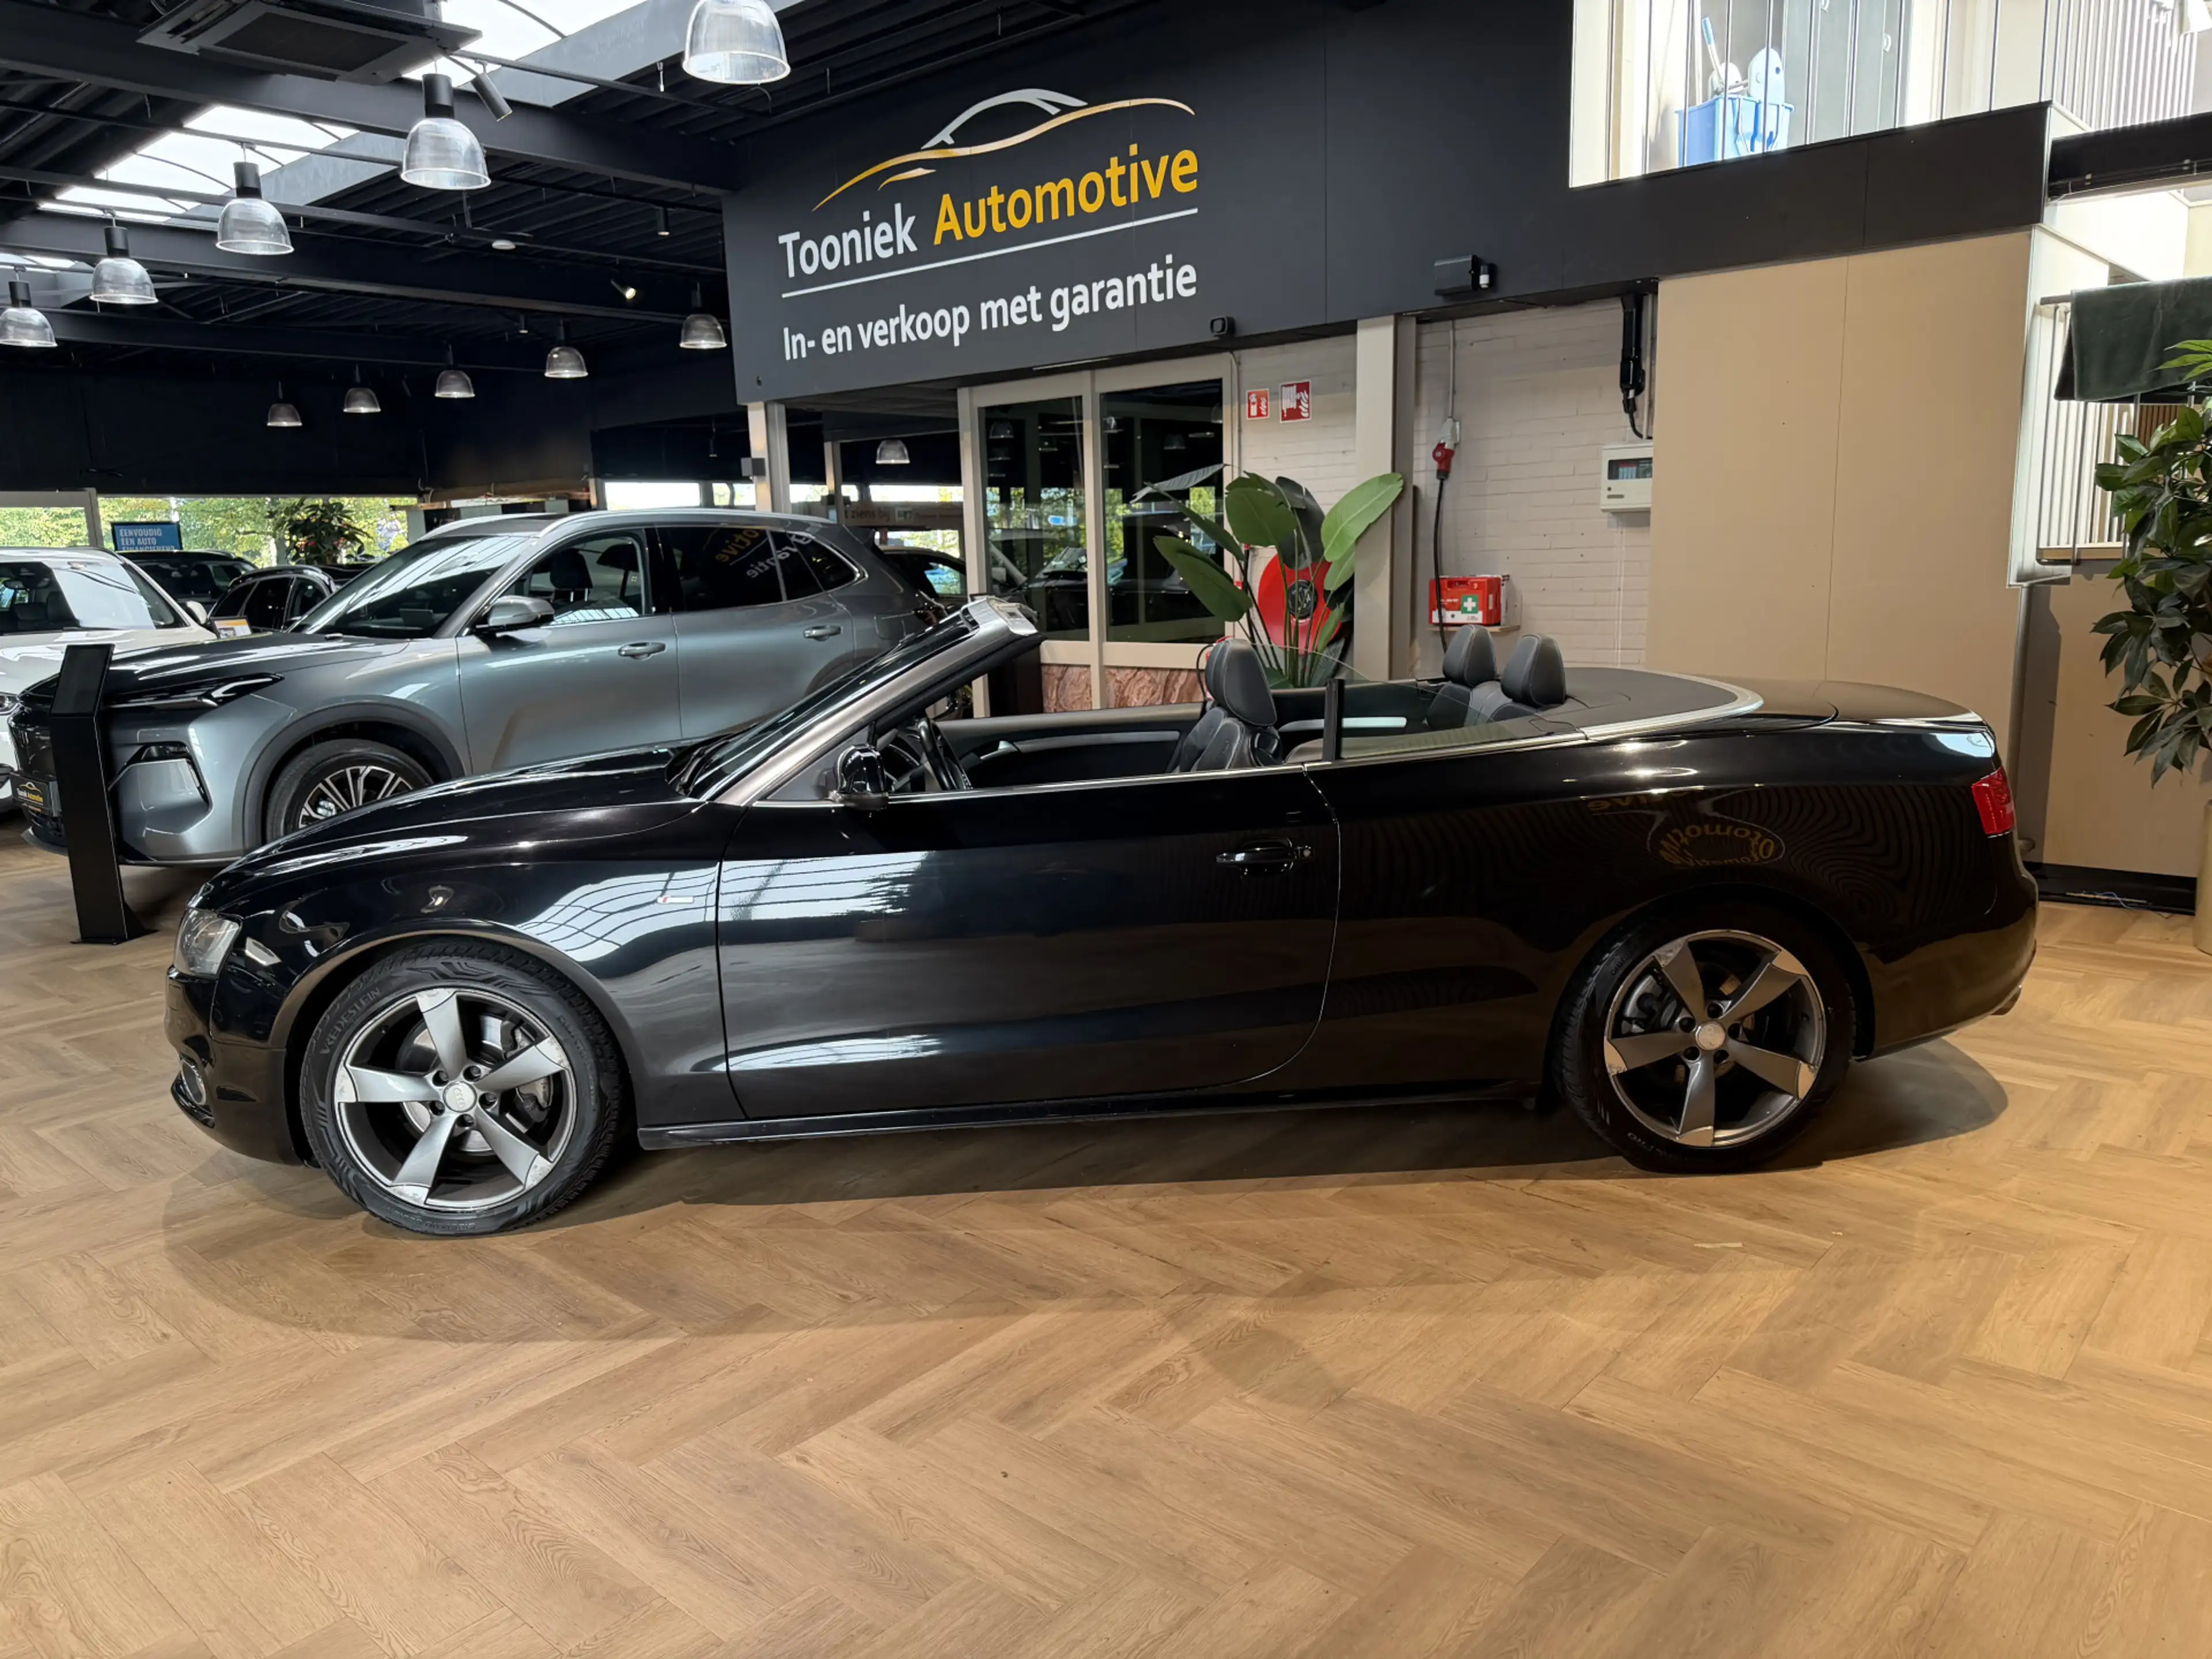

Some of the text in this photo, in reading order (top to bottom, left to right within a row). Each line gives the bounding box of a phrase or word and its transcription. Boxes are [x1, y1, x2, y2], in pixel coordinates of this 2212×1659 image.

[778, 143, 1198, 278] Tooniek Automotive
[783, 253, 1198, 361] In- en verkoop met garantie
[119, 529, 162, 537] EENVOUDIG
[137, 537, 157, 546] AUTO
